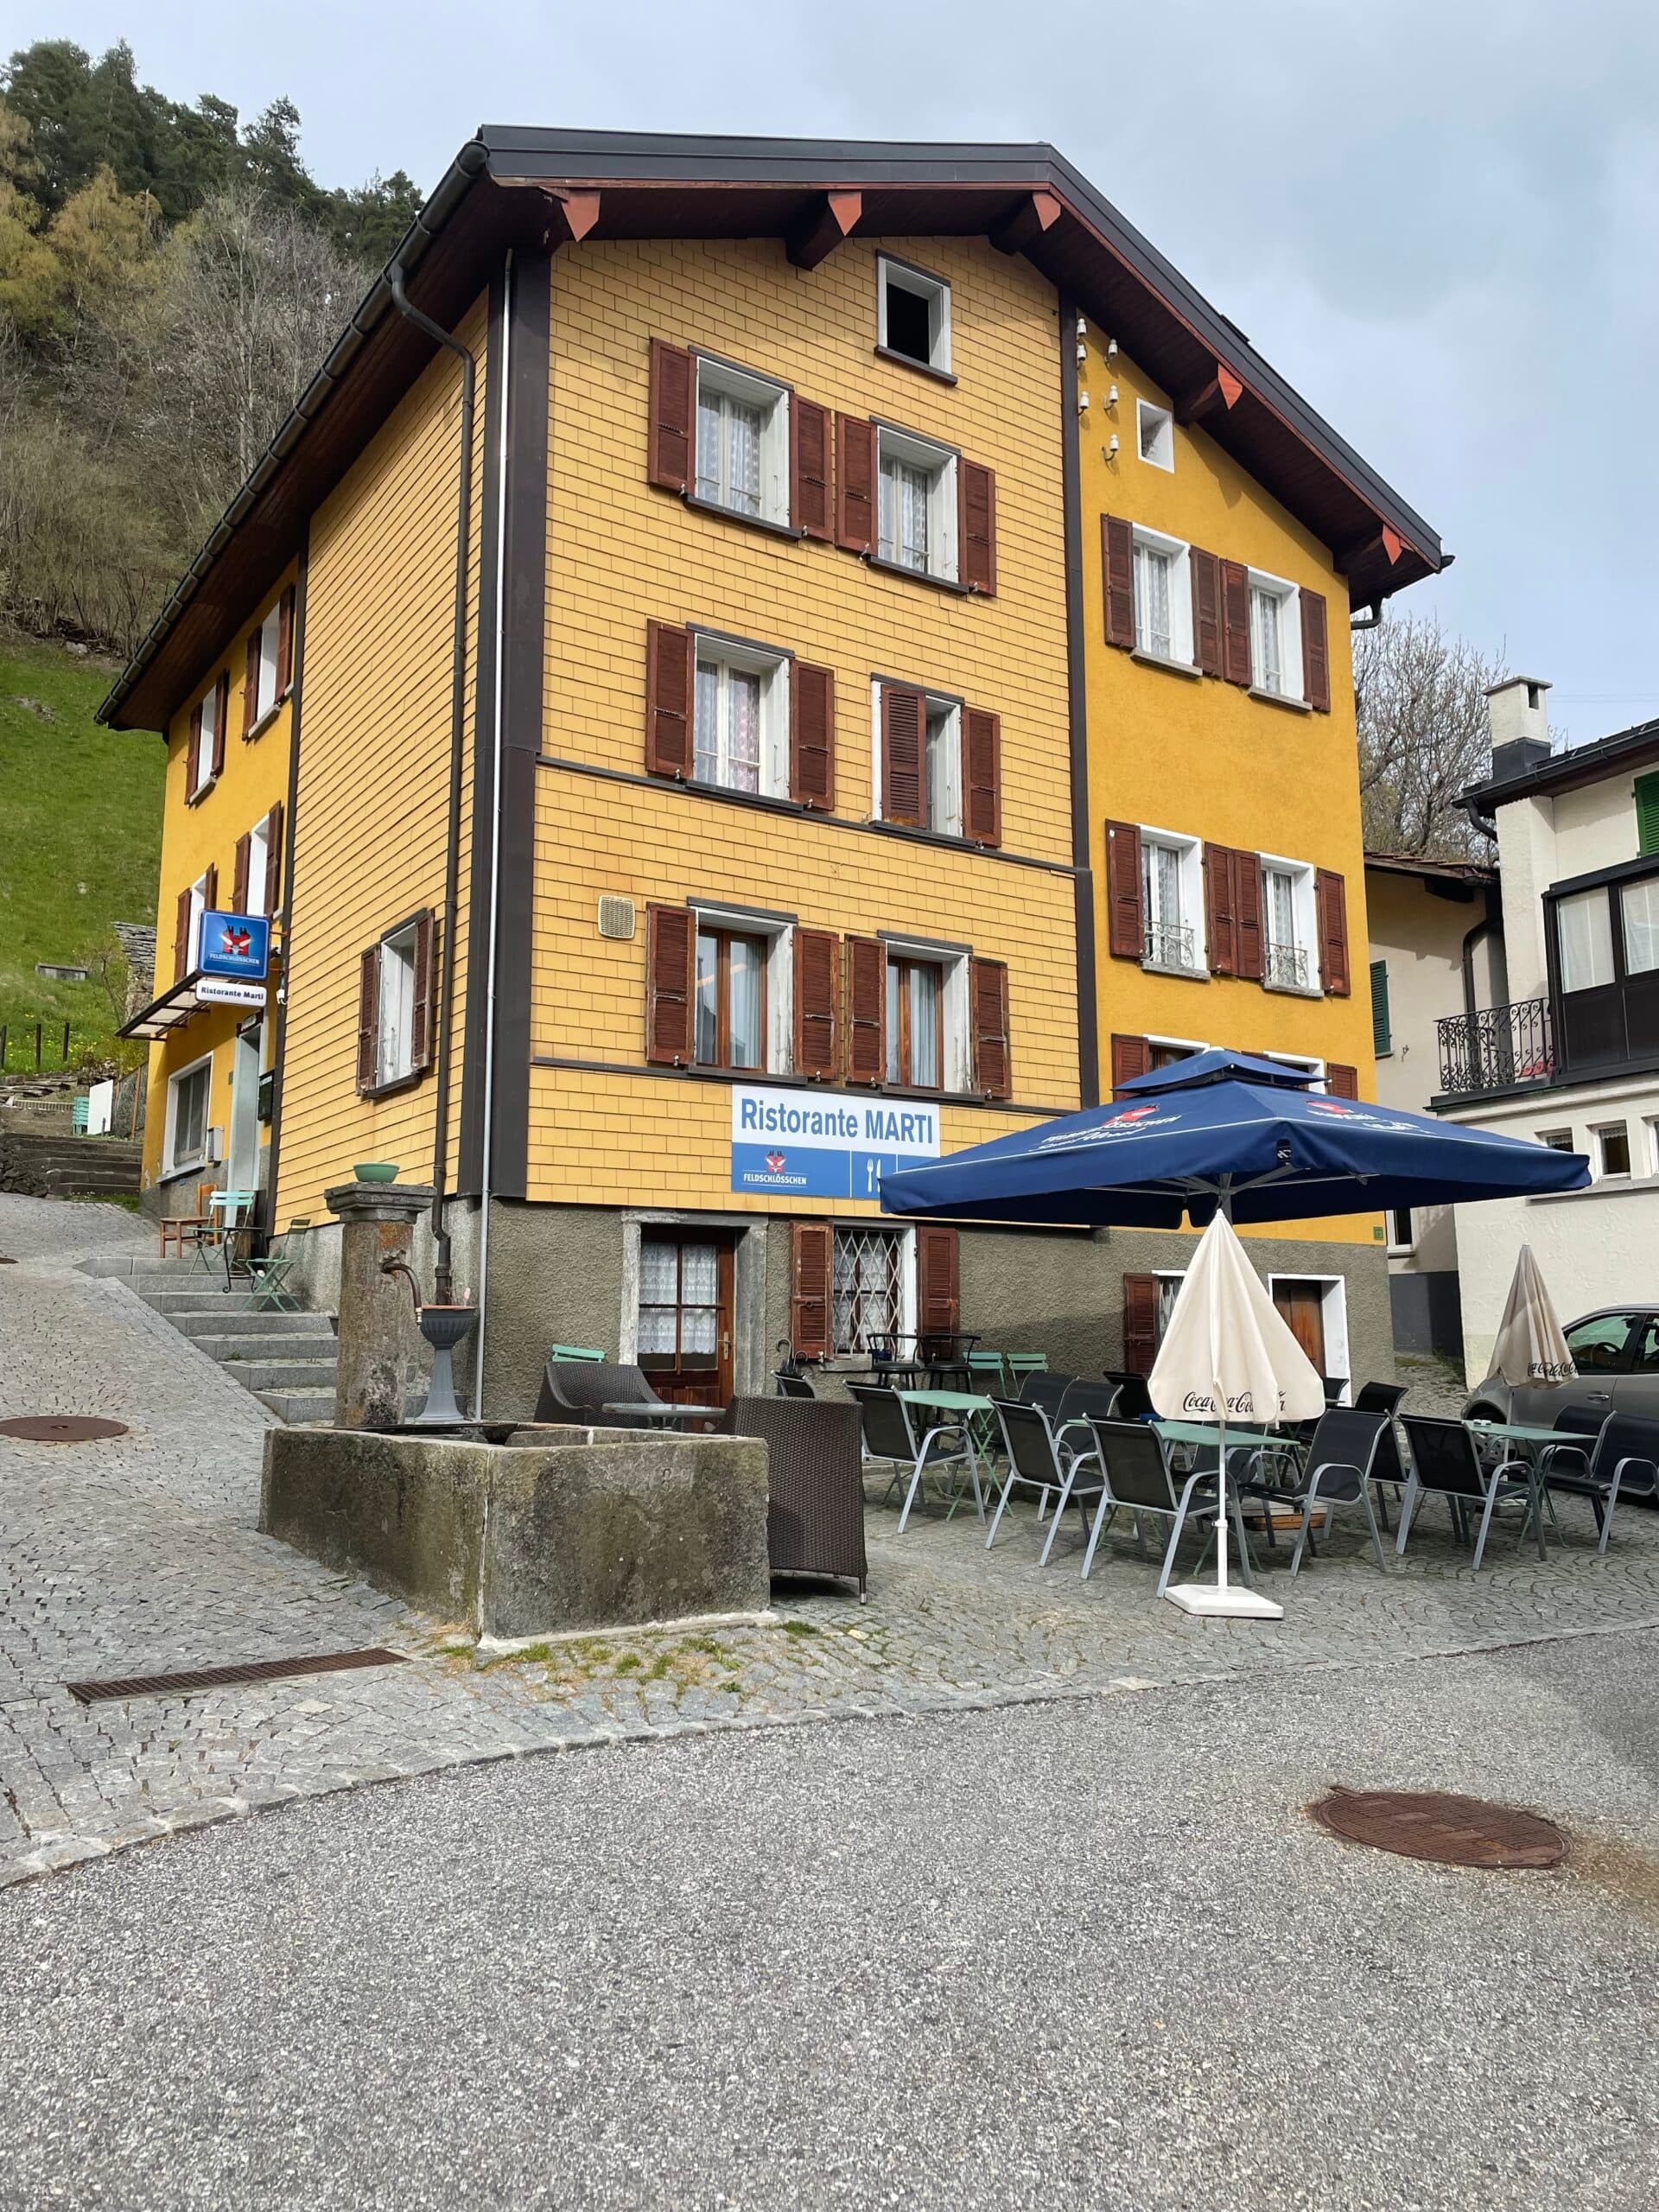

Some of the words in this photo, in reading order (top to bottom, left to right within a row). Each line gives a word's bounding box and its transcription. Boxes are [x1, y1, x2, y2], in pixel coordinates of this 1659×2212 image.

[200, 987, 242, 997] Ristorante
[741, 1098, 858, 1138] Ristorante
[865, 1109, 932, 1144] MARTI
